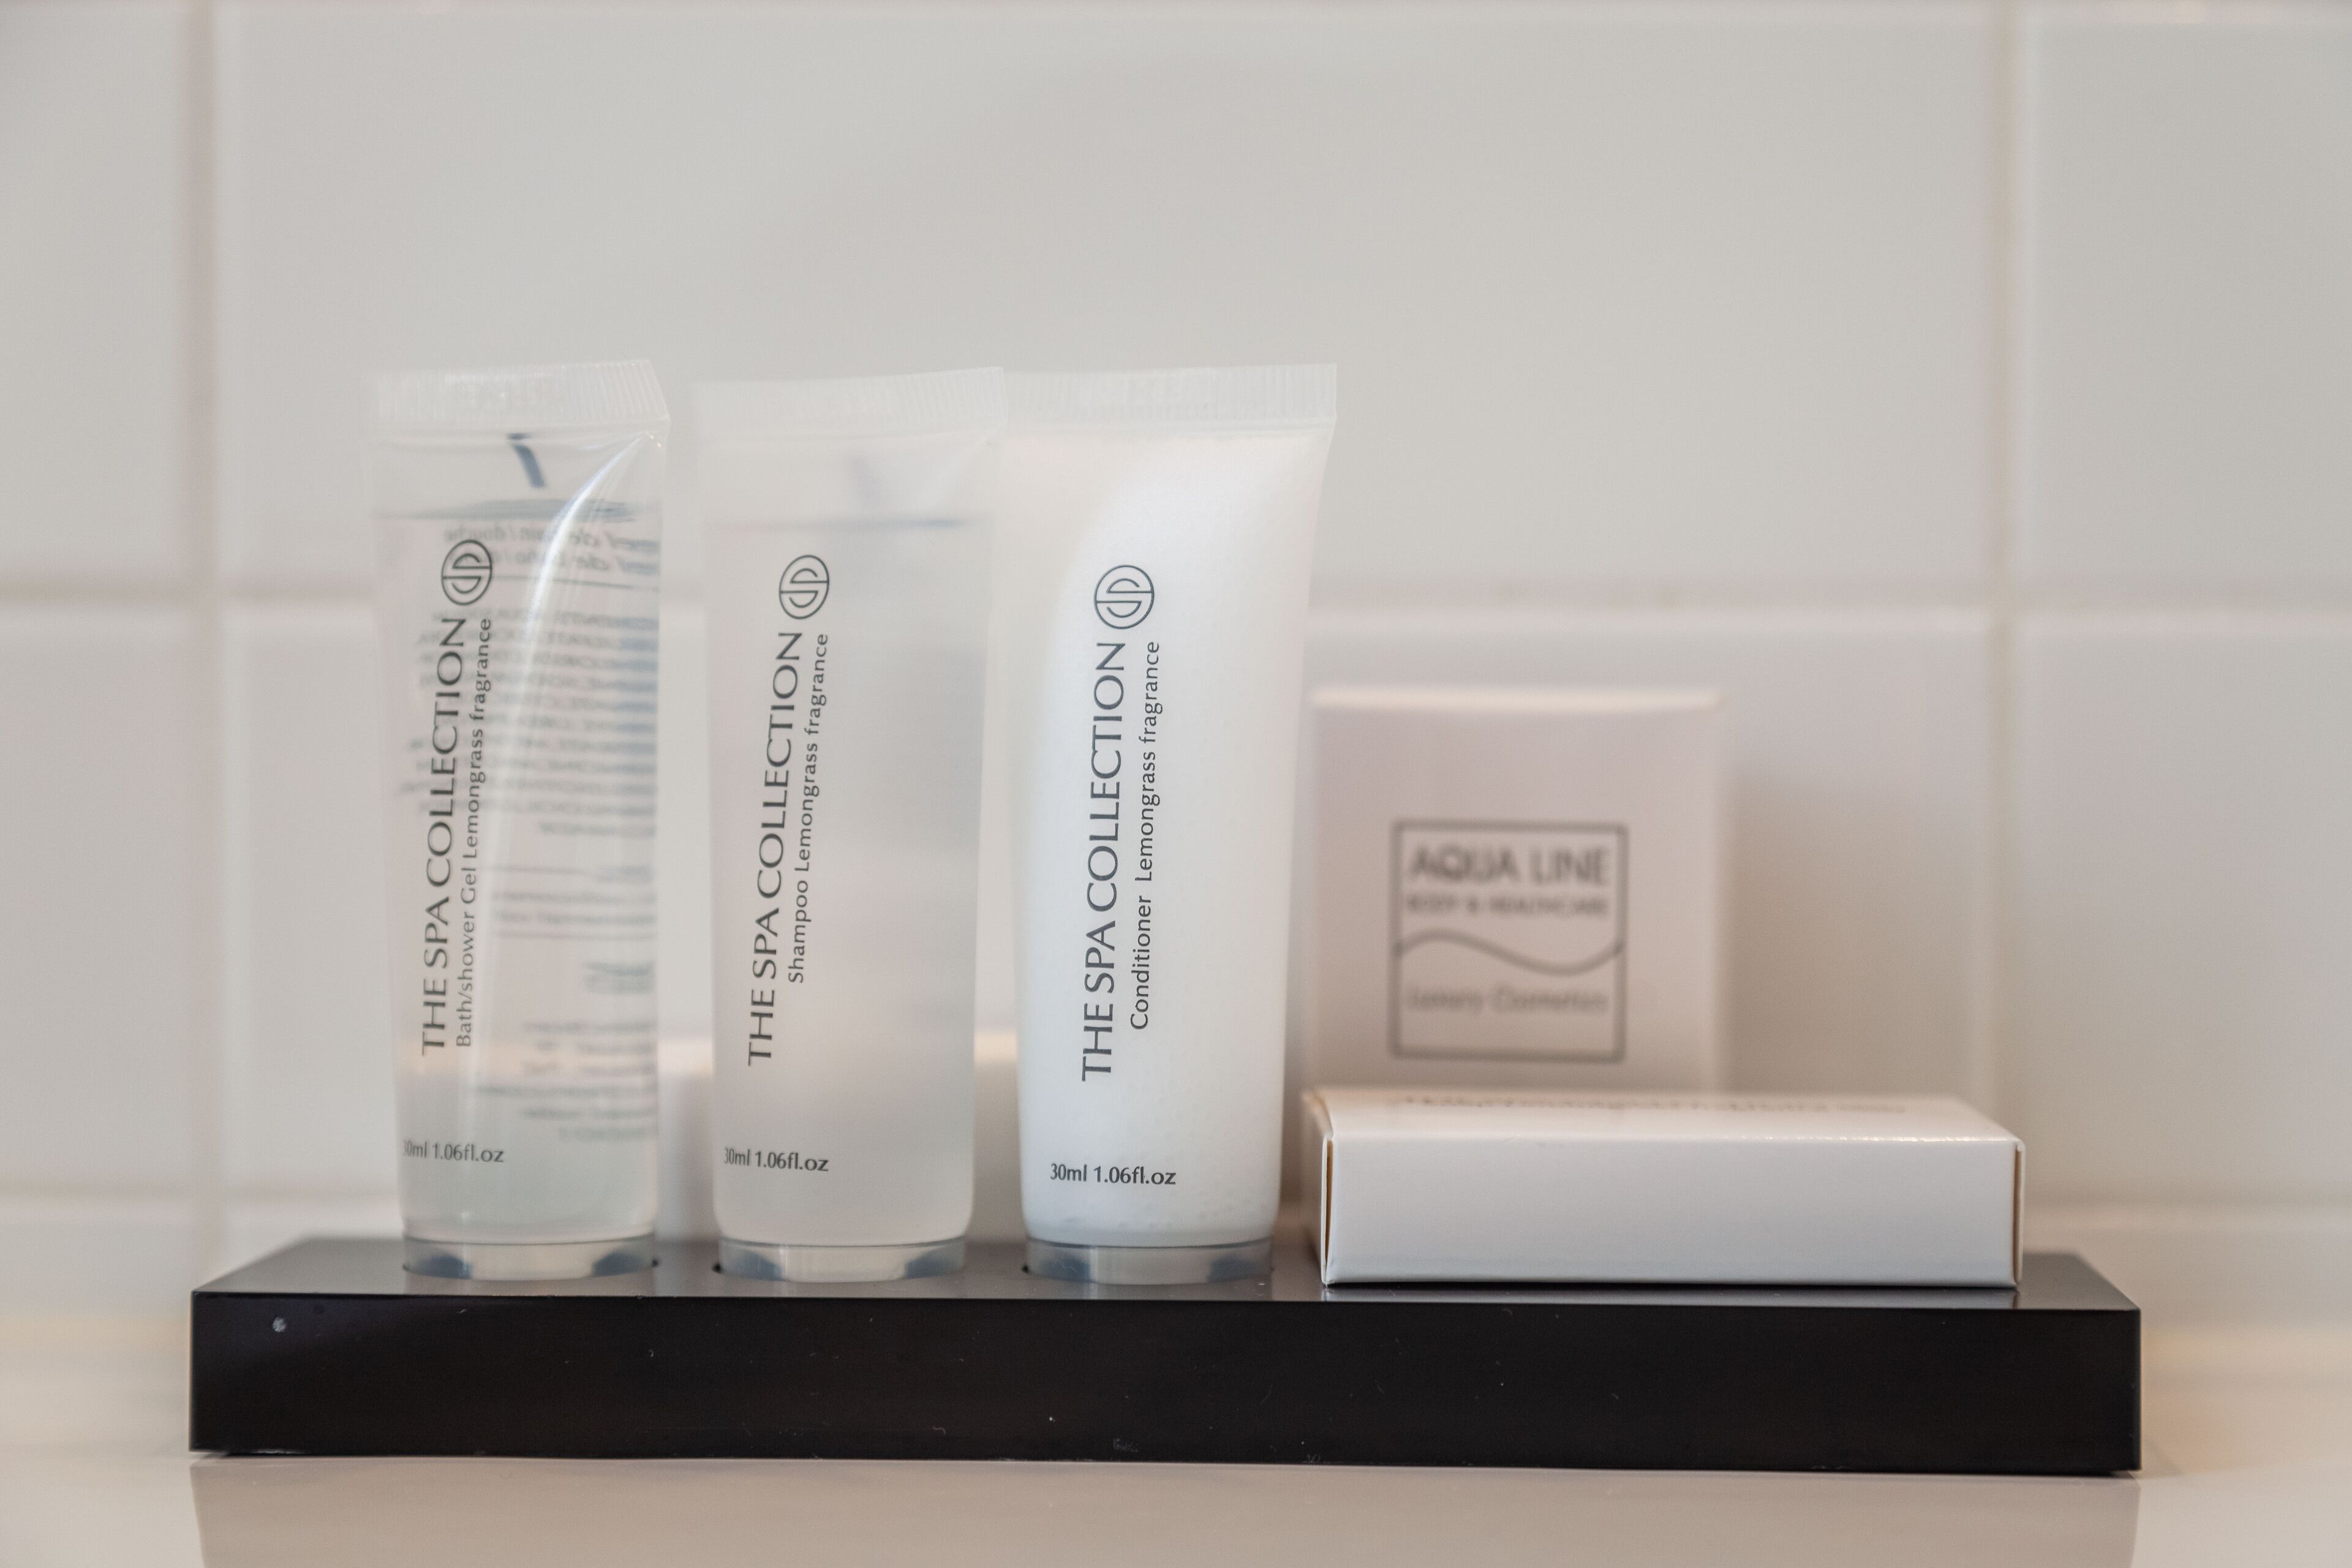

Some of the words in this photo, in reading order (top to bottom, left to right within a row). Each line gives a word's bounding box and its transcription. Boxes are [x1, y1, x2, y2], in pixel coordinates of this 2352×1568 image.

[469, 619, 491, 721] fragrance
[804, 633, 828, 736] fragrance
[1139, 641, 1163, 744] fragrance
[426, 618, 466, 888] COLLECTION
[462, 726, 486, 858] Lemongrass
[757, 632, 802, 899] COLLECTION
[1087, 642, 1126, 912] COLLECTION
[795, 743, 820, 872] Lemongrass
[1135, 752, 1160, 881] Lemongrass
[461, 867, 477, 904] Gel
[1410, 843, 1521, 884] AQUA
[1532, 845, 1609, 886] LINE
[424, 896, 450, 968] SPA
[456, 911, 475, 1047] Bath/shower
[753, 907, 779, 979] SPA
[788, 881, 812, 983] Shampoo
[1084, 921, 1116, 994] SPA
[1130, 895, 1152, 1030] Conditioner
[422, 978, 447, 1056] THE
[748, 989, 775, 1066] THE
[1082, 1003, 1113, 1082] THE
[432, 1143, 504, 1163] 1.06fl.oz
[724, 1147, 750, 1166] 30ml
[755, 1150, 829, 1172] 1.06fl.oz
[1050, 1163, 1087, 1183] 30ml
[1093, 1166, 1176, 1185] 1.06fl.oz
